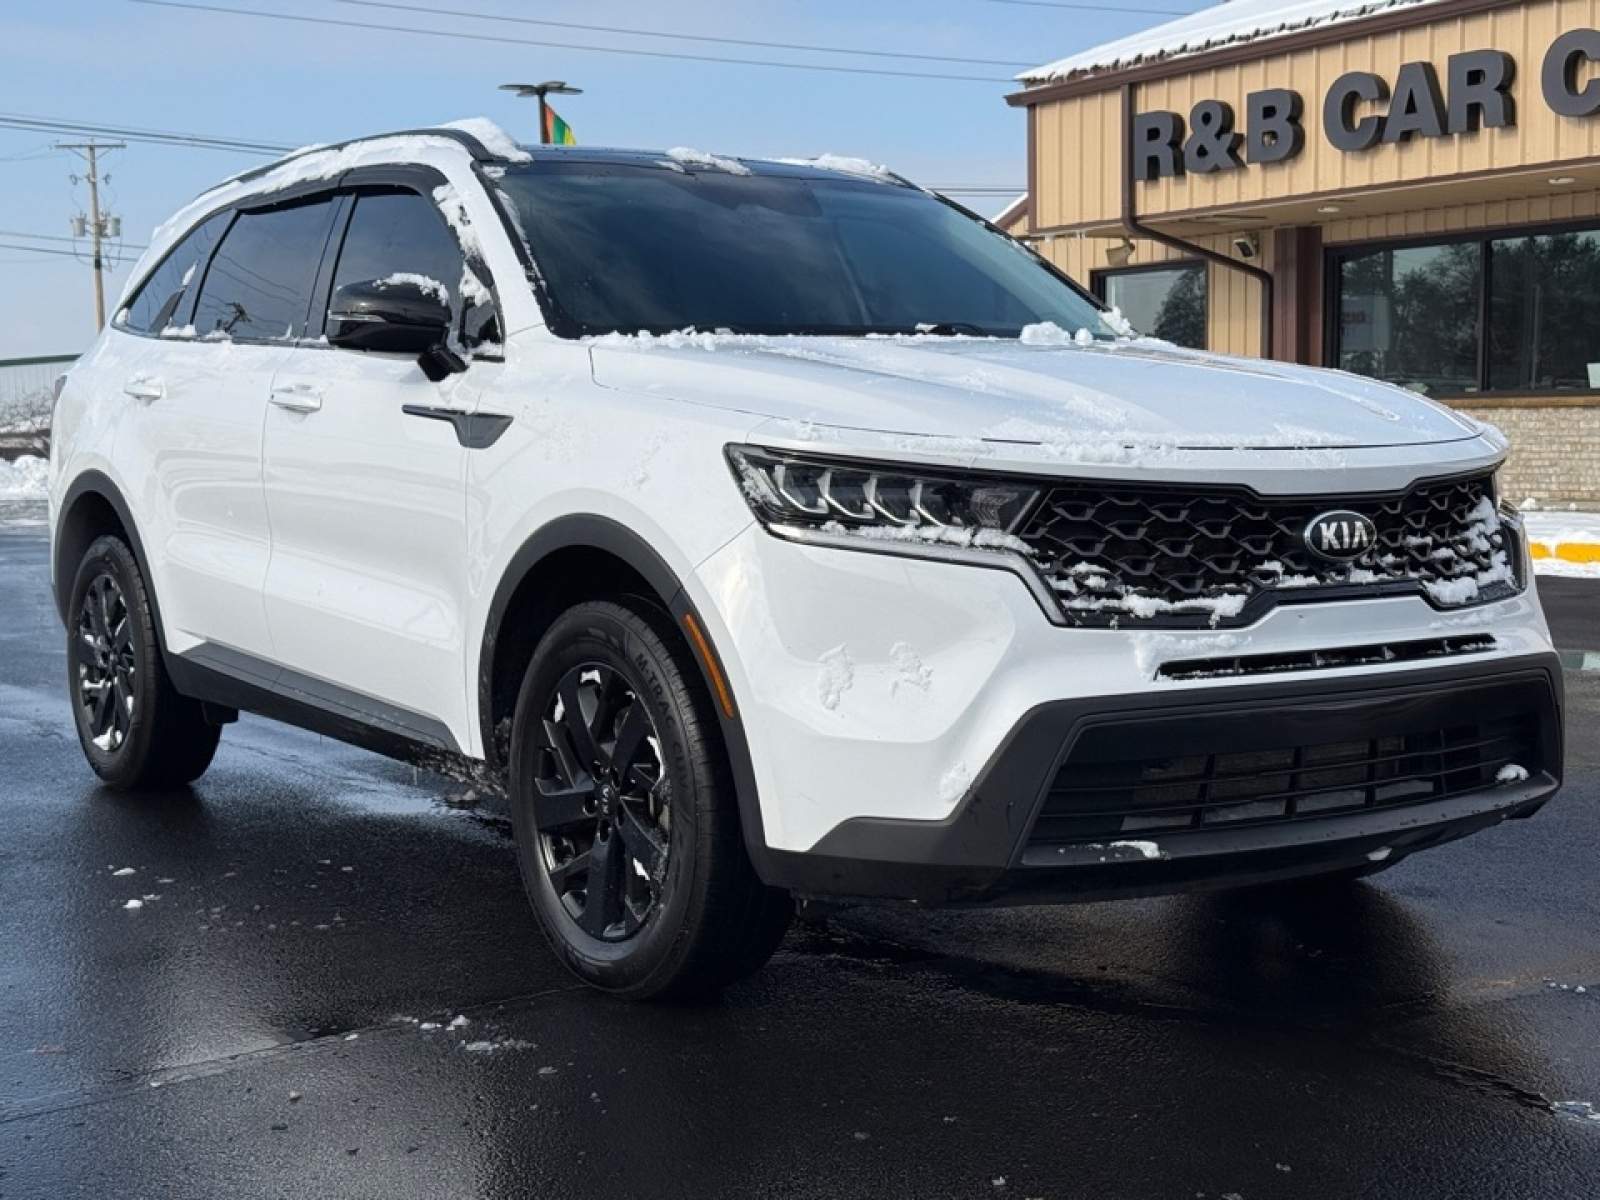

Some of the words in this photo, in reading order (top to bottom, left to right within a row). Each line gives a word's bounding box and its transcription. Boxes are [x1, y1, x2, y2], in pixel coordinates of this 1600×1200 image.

[1134, 88, 1304, 181] R&B
[1323, 49, 1515, 151] CAR
[1319, 521, 1369, 550] KIA
